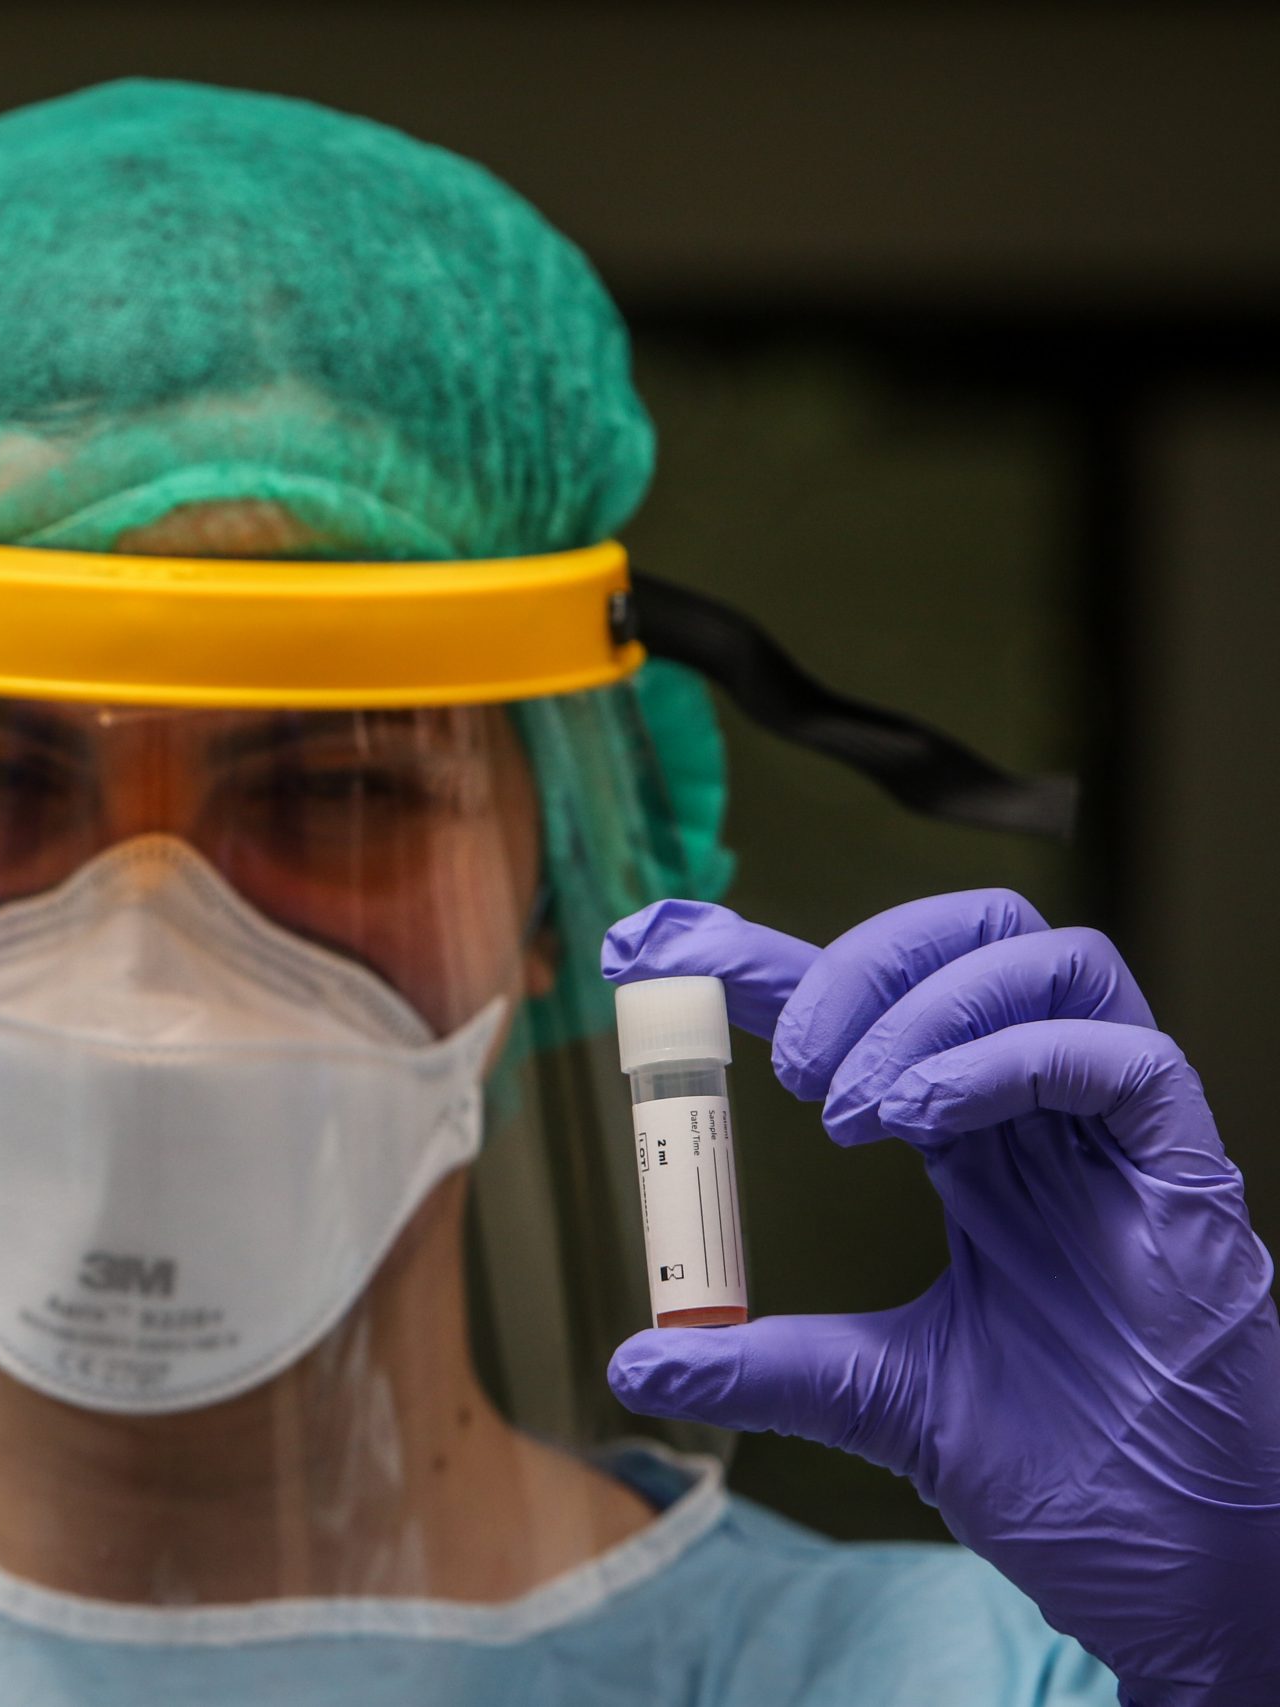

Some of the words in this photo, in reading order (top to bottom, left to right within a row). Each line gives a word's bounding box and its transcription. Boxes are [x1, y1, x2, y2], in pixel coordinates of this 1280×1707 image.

[690, 1110, 701, 1134] Date/
[708, 1109, 718, 1141] Sample
[657, 1139, 667, 1148] 2
[692, 1134, 701, 1157] Time
[658, 1150, 669, 1166] ml
[78, 1252, 177, 1298] 3M
